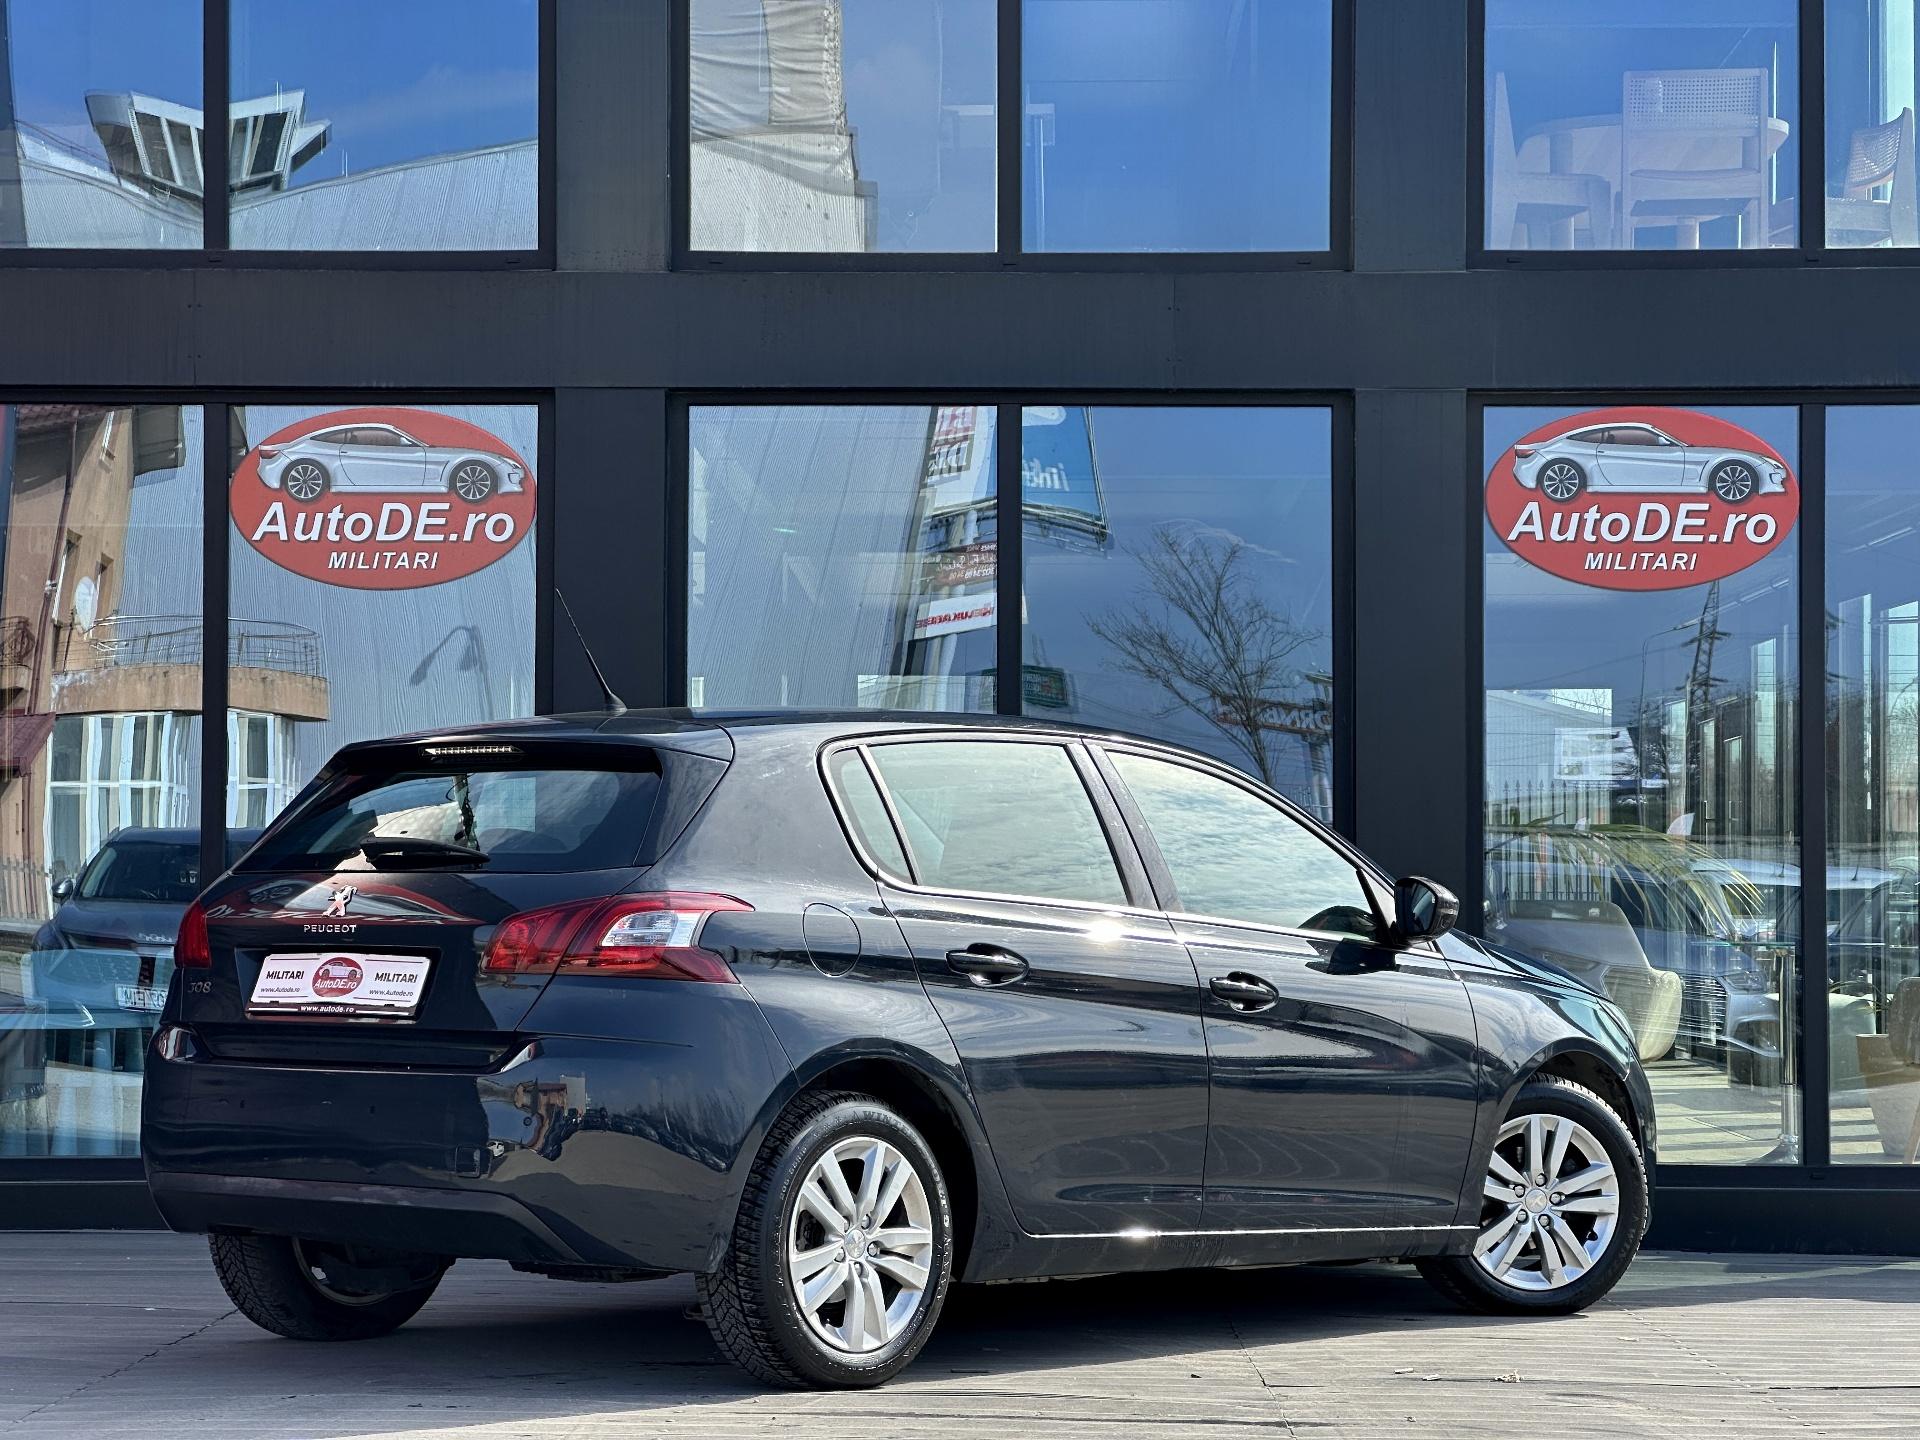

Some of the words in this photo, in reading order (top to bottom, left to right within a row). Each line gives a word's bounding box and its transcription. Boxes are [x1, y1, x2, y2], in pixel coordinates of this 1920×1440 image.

[252, 501, 516, 543] AutoDE.ro
[1507, 501, 1777, 544] AutoDE.ro
[328, 551, 439, 570] MILITARI
[1584, 552, 1698, 571] MILITARI
[303, 924, 357, 933] PEUGEOT
[265, 970, 305, 980] MILITARI
[374, 972, 418, 983] MILITARI
[313, 978, 358, 990] AutoDE.ro
[260, 986, 301, 994] www.Autode.ro
[368, 988, 414, 997] www.Autode.ro
[300, 1004, 355, 1014] www.autode.ro
